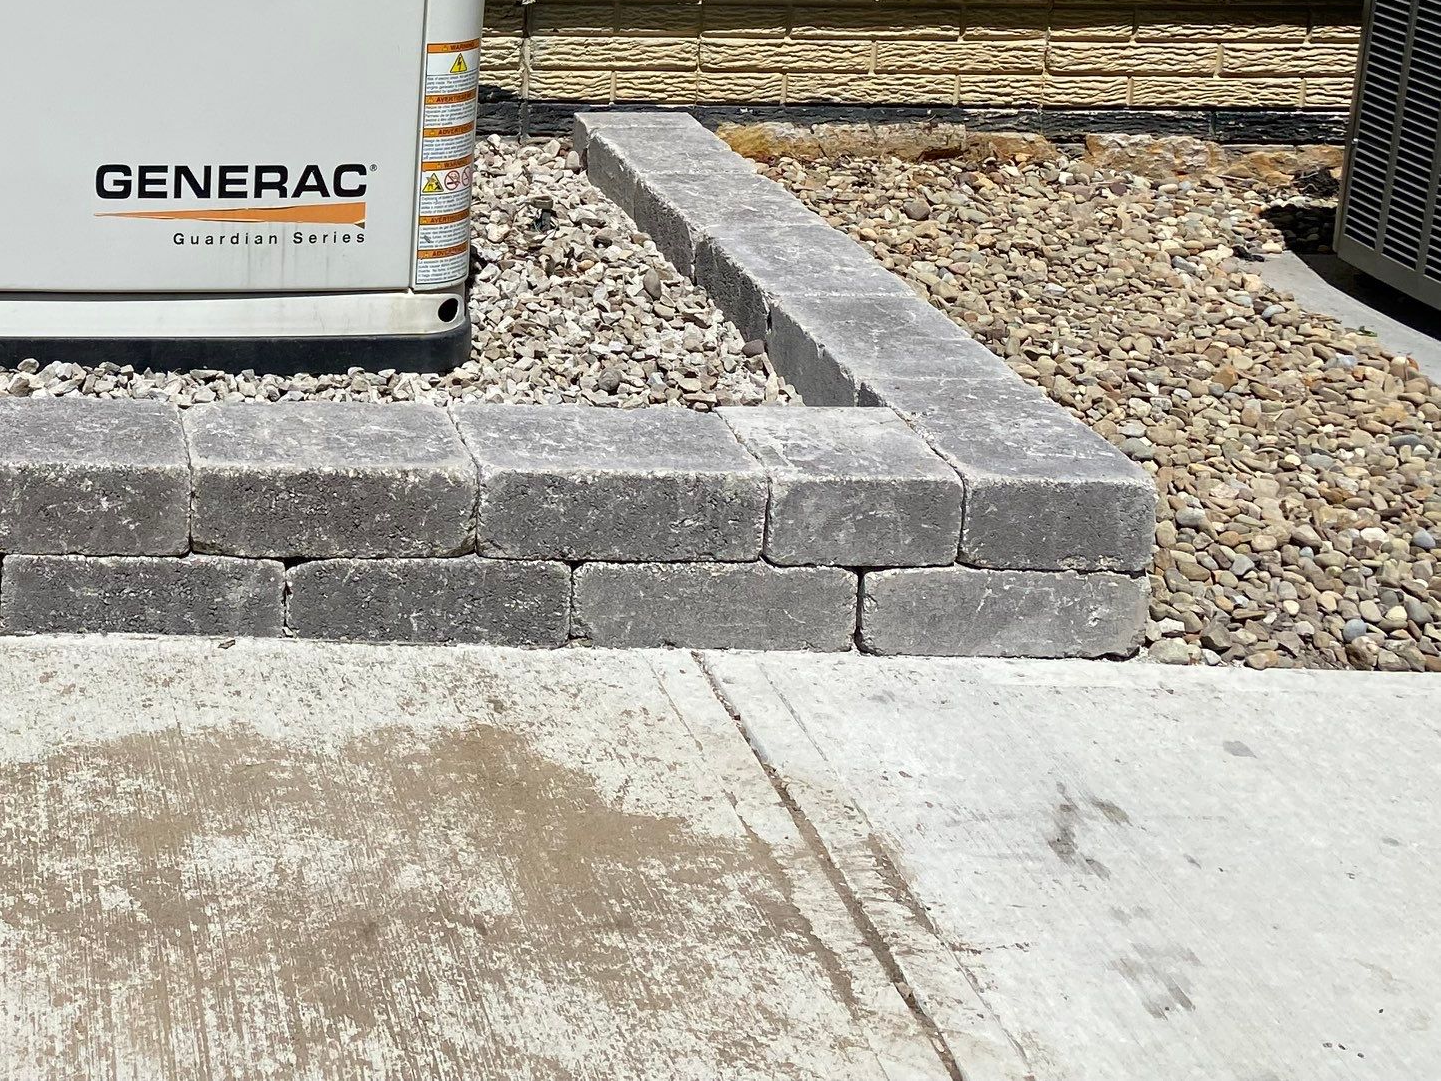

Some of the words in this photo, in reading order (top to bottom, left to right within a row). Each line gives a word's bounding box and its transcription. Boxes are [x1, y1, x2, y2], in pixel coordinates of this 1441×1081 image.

[95, 164, 367, 200] GENERAC
[173, 232, 278, 245] Guardian
[293, 231, 366, 244] Series
